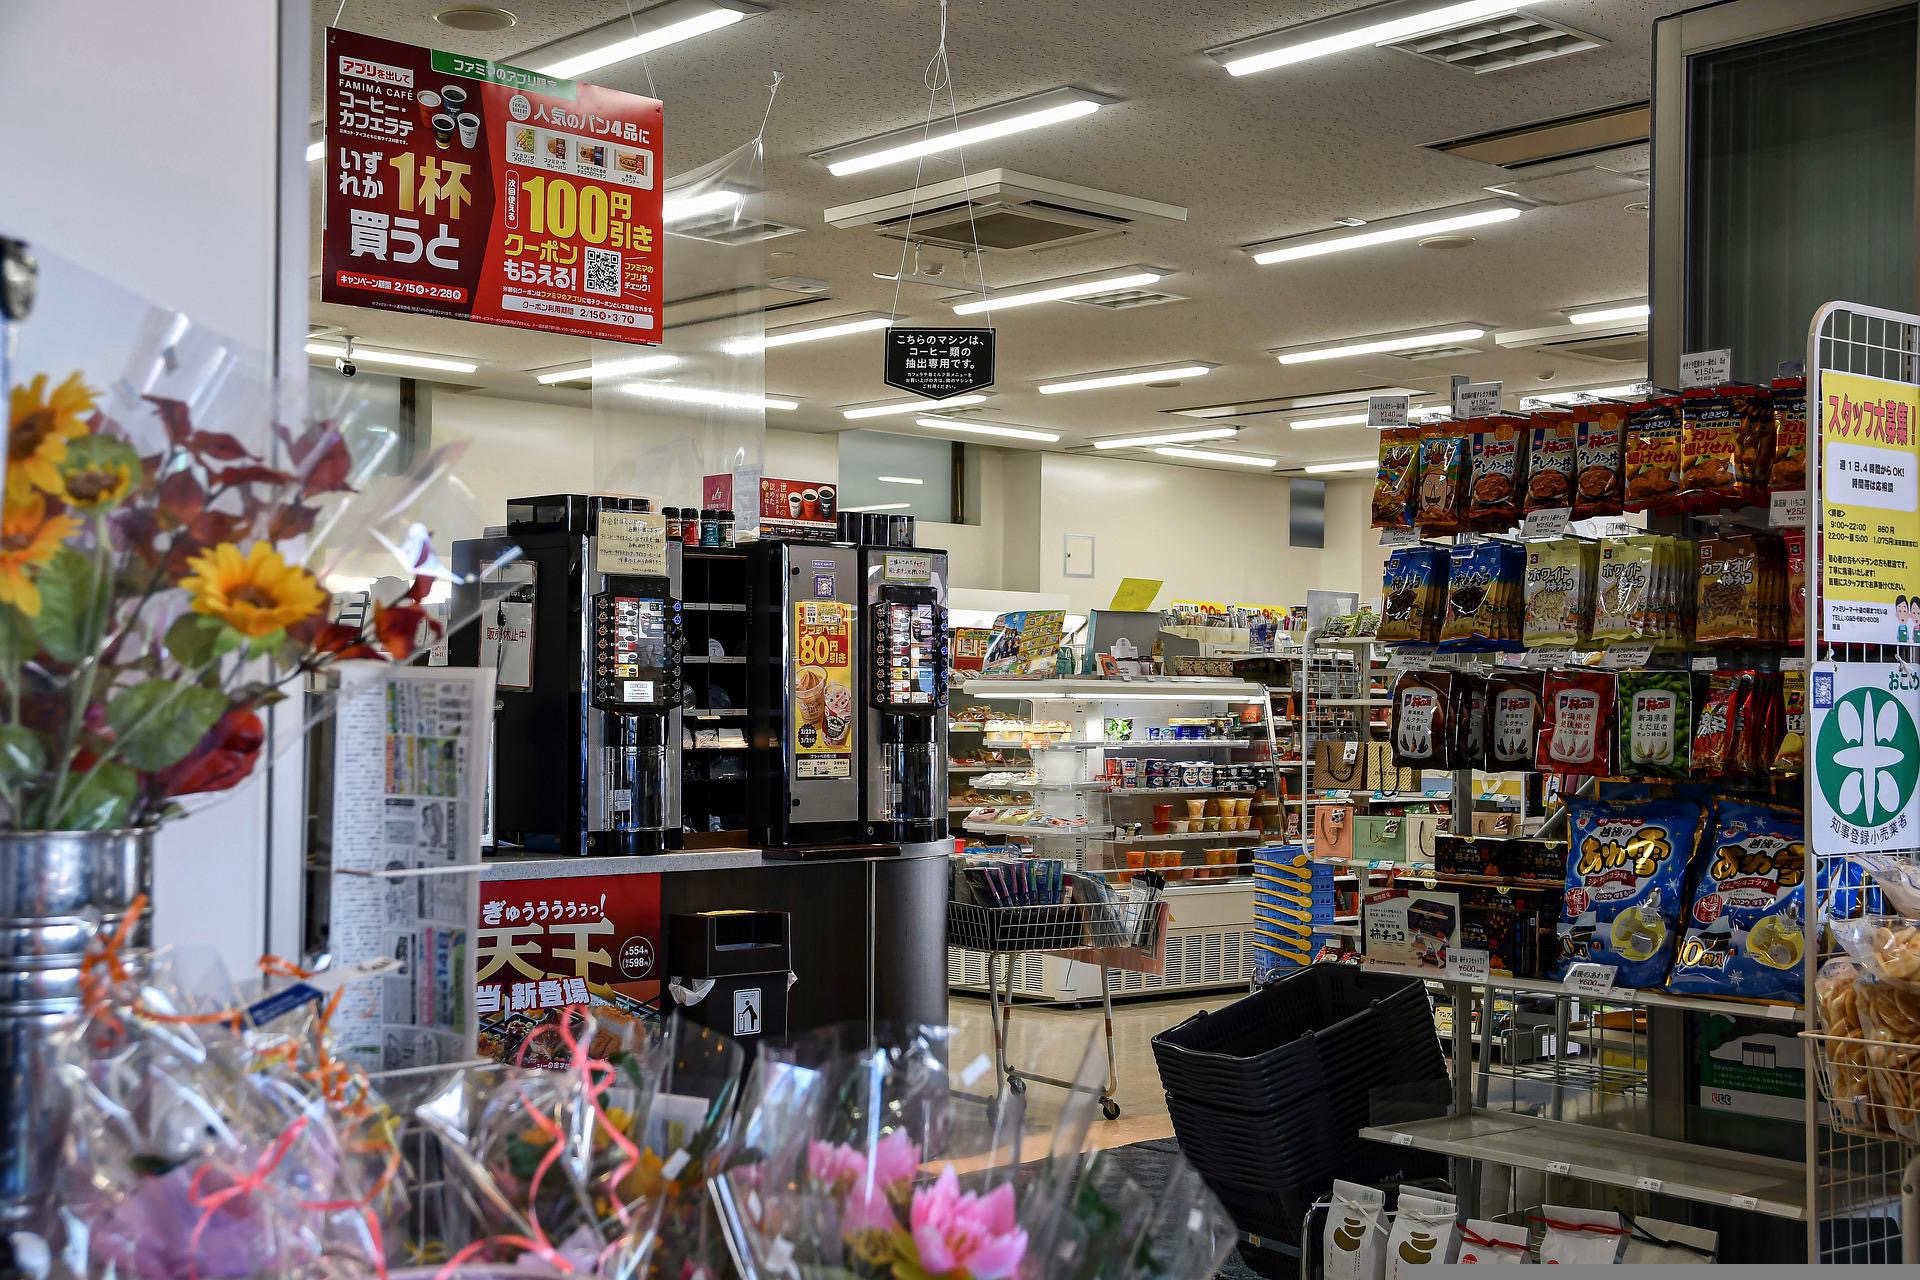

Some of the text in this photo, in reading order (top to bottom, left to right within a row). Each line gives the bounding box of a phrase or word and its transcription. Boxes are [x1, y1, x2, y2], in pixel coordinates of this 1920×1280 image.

[343, 60, 411, 85] アプリを出して
[338, 78, 413, 101] FAMIMA CAFÉ
[340, 109, 414, 137] カフェラテ
[534, 103, 650, 144] 人気のパン4品に
[340, 147, 382, 172] いず
[340, 172, 383, 200] れか
[350, 209, 460, 271] 買うと
[504, 233, 578, 265] クーポン
[624, 262, 654, 274] ファミマの
[340, 274, 392, 290] キャンペーン期間
[624, 271, 648, 283] アプリを
[522, 301, 575, 315] クーポン利用期間
[897, 335, 984, 346] こちらのマシンは、
[909, 346, 971, 357] コーヒー類の
[905, 358, 975, 370] 抽出専用です。
[1692, 429, 1731, 441] カレー
[1851, 478, 1894, 494] 時間帯は応相談
[1528, 566, 1570, 581] ホワイト
[486, 627, 527, 642] 販売休止中
[1561, 711, 1591, 721] 新潟県産
[1638, 714, 1668, 722] 新潟県産
[1637, 722, 1668, 731] えだ豆の
[1600, 826, 1632, 837] 越後の
[1830, 812, 1908, 846] 知事登録小売業者
[1748, 839, 1783, 849] 越後の
[1370, 928, 1405, 941] 柿チョコ
[1459, 964, 1476, 972] ¥600
[511, 978, 591, 1010] 新登場
